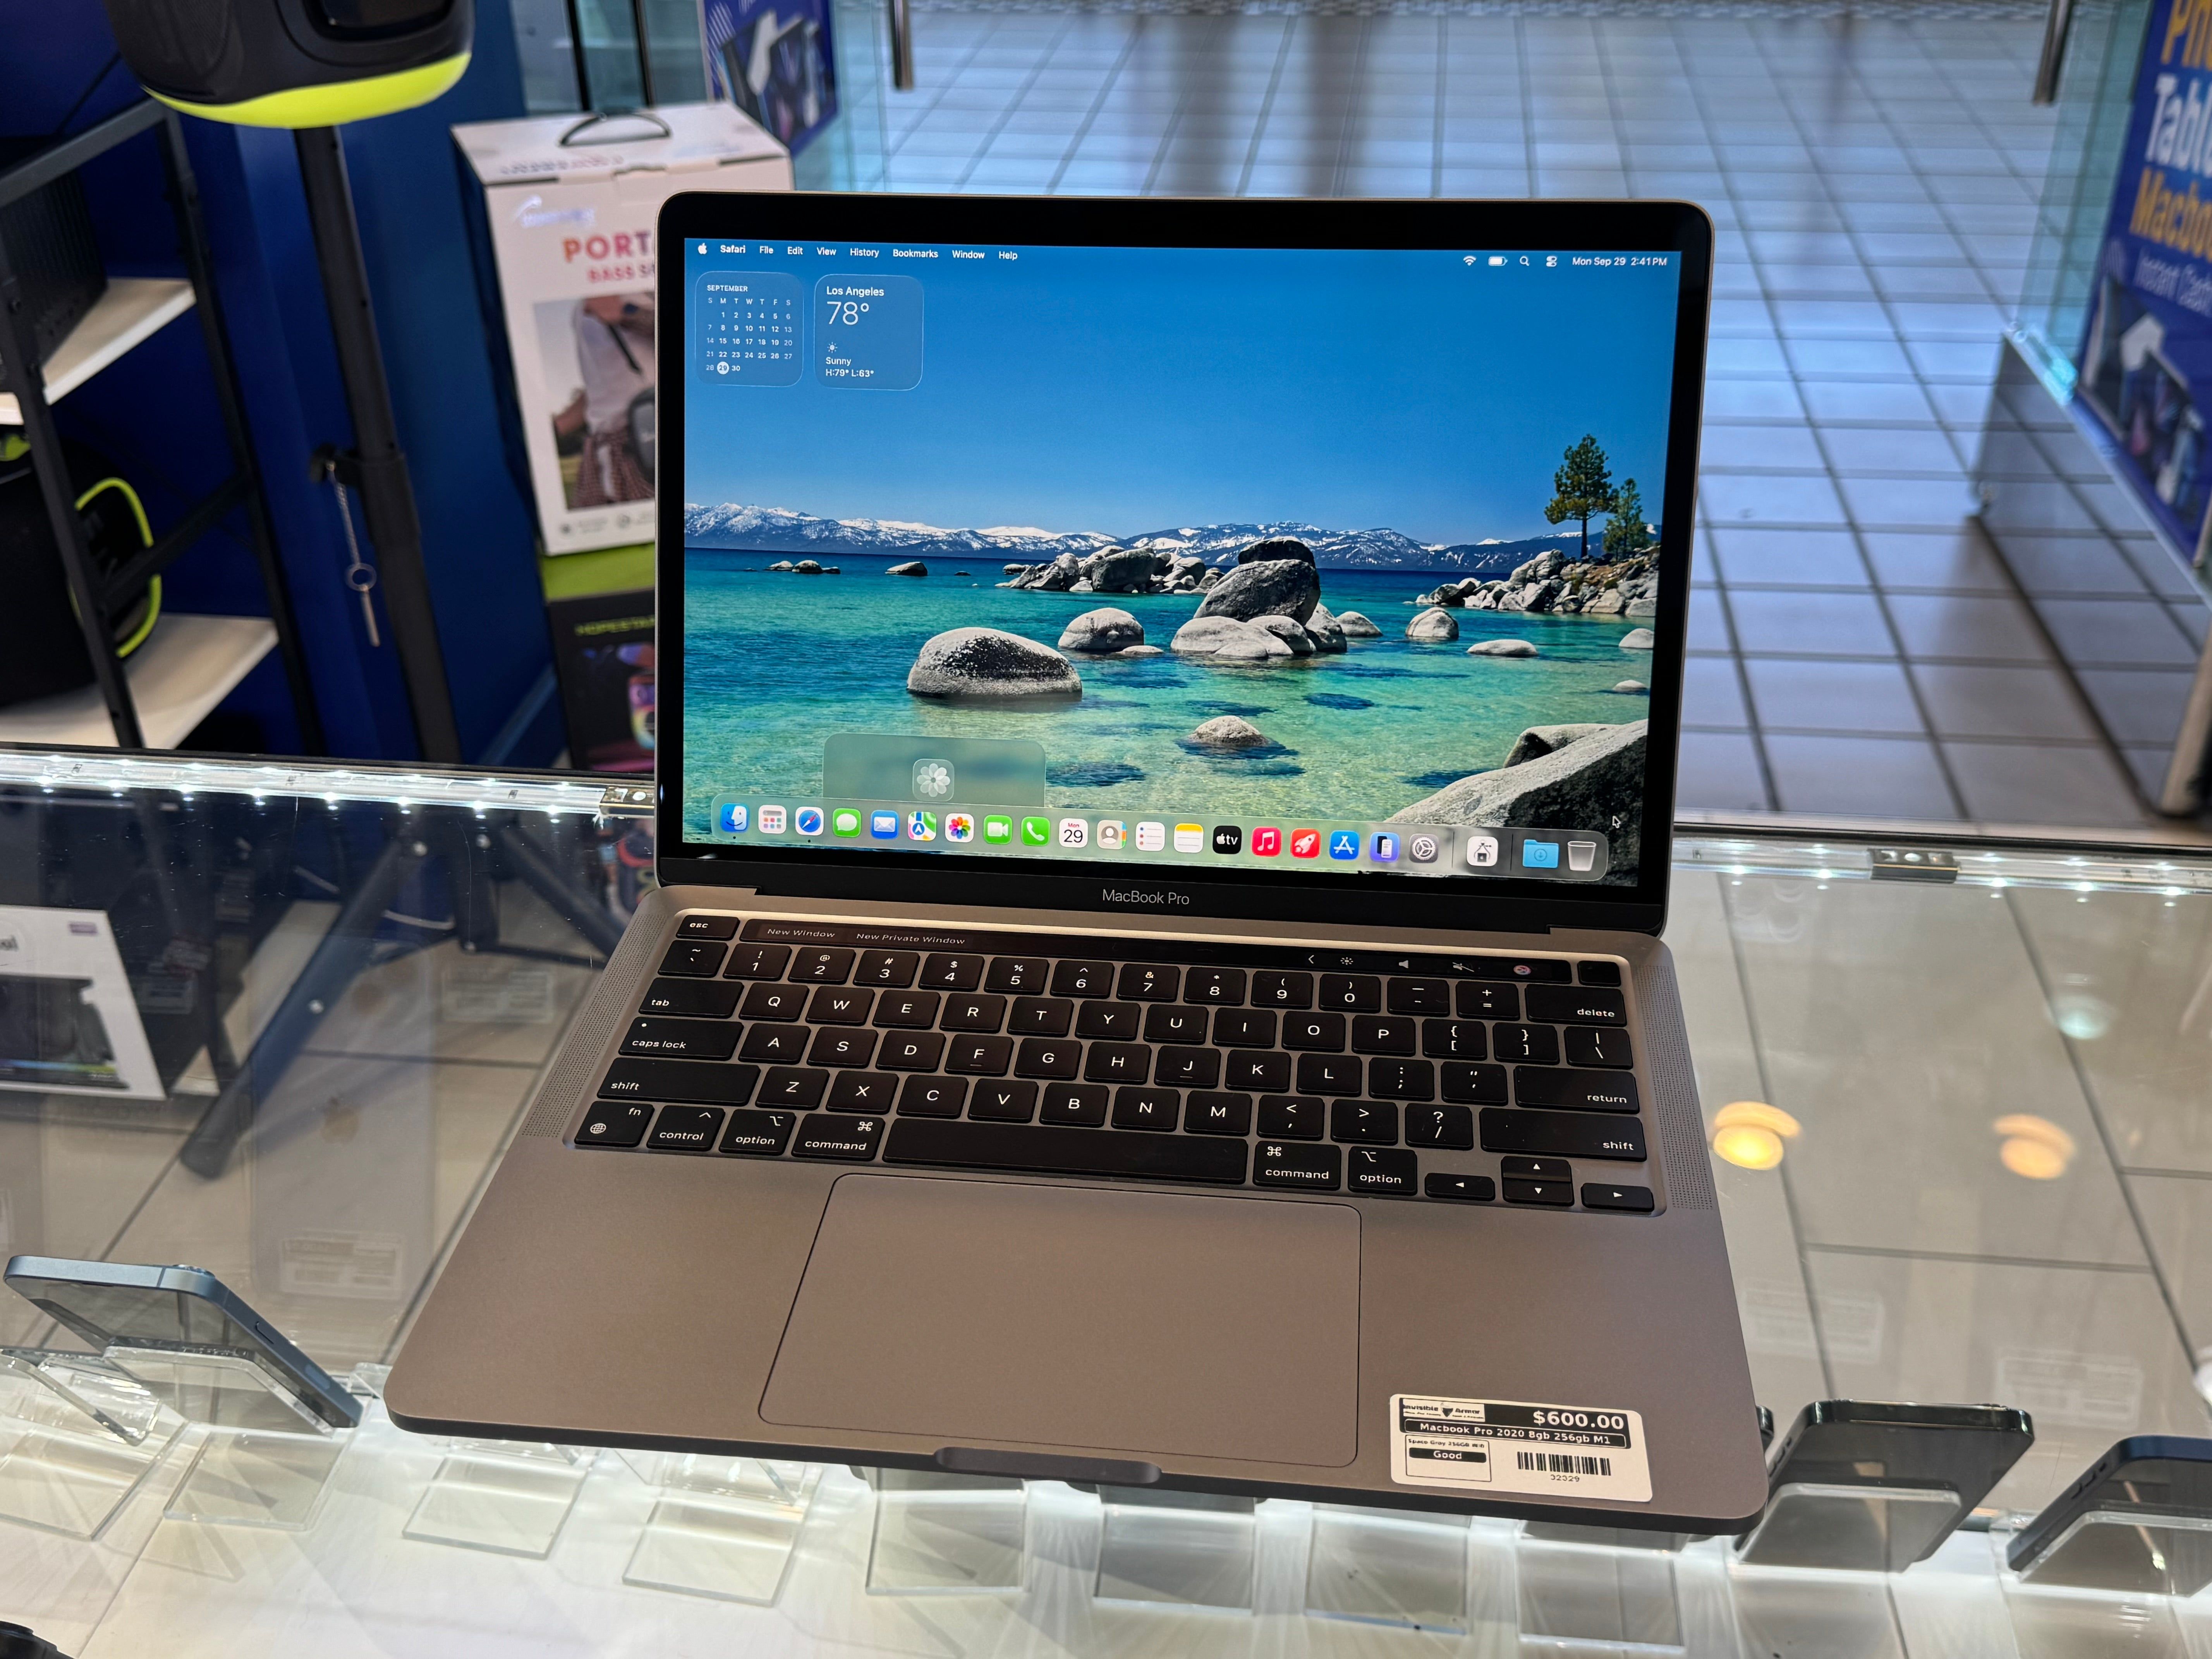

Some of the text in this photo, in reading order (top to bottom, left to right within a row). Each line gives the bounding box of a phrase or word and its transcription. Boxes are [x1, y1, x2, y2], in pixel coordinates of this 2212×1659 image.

[720, 245, 1018, 261] Safari File Edit View History Bookmarks Window Help
[1572, 257, 1592, 265] Mon
[1594, 257, 1611, 267] Sep
[1614, 257, 1626, 266] 29
[827, 286, 884, 298] Los Angeles
[827, 301, 869, 325] 78°
[826, 357, 851, 366] Sunny
[826, 368, 874, 377] H:79° L:63°
[1064, 829, 1083, 843] 29
[1103, 889, 1190, 905] MacBook Pro
[752, 962, 1355, 1002] 1 2 3 4 5 6 7 8 9 0
[768, 996, 781, 1007] Q
[834, 1000, 850, 1010] W
[901, 1004, 912, 1013] E
[967, 1007, 979, 1017] R
[1036, 1010, 1047, 1020] T
[1104, 1014, 1114, 1024] Y
[1170, 1018, 1182, 1028] U
[1243, 1022, 1247, 1032] I
[1308, 1025, 1320, 1035] O
[1378, 1029, 1389, 1039] P
[1577, 1008, 1615, 1017] delete
[662, 1041, 686, 1049] lock
[768, 1037, 1627, 1103] A S D F G H J K L return
[611, 1082, 1226, 1118] shift Z X C V B N M
[629, 1108, 641, 1116] fn
[1433, 1111, 1443, 1123] ?
[659, 1132, 704, 1140] control
[736, 1136, 775, 1145] option
[805, 1141, 867, 1150] command
[1603, 1141, 1634, 1151] shift
[1266, 1170, 1329, 1179] command
[1360, 1175, 1401, 1184] option
[1533, 1410, 1624, 1430] $600.00
[1420, 1423, 1611, 1444] Macbook Pro 2020 8gb 256gb M1
[1433, 1450, 1462, 1460] Good
[1551, 1474, 1580, 1482] 32329
